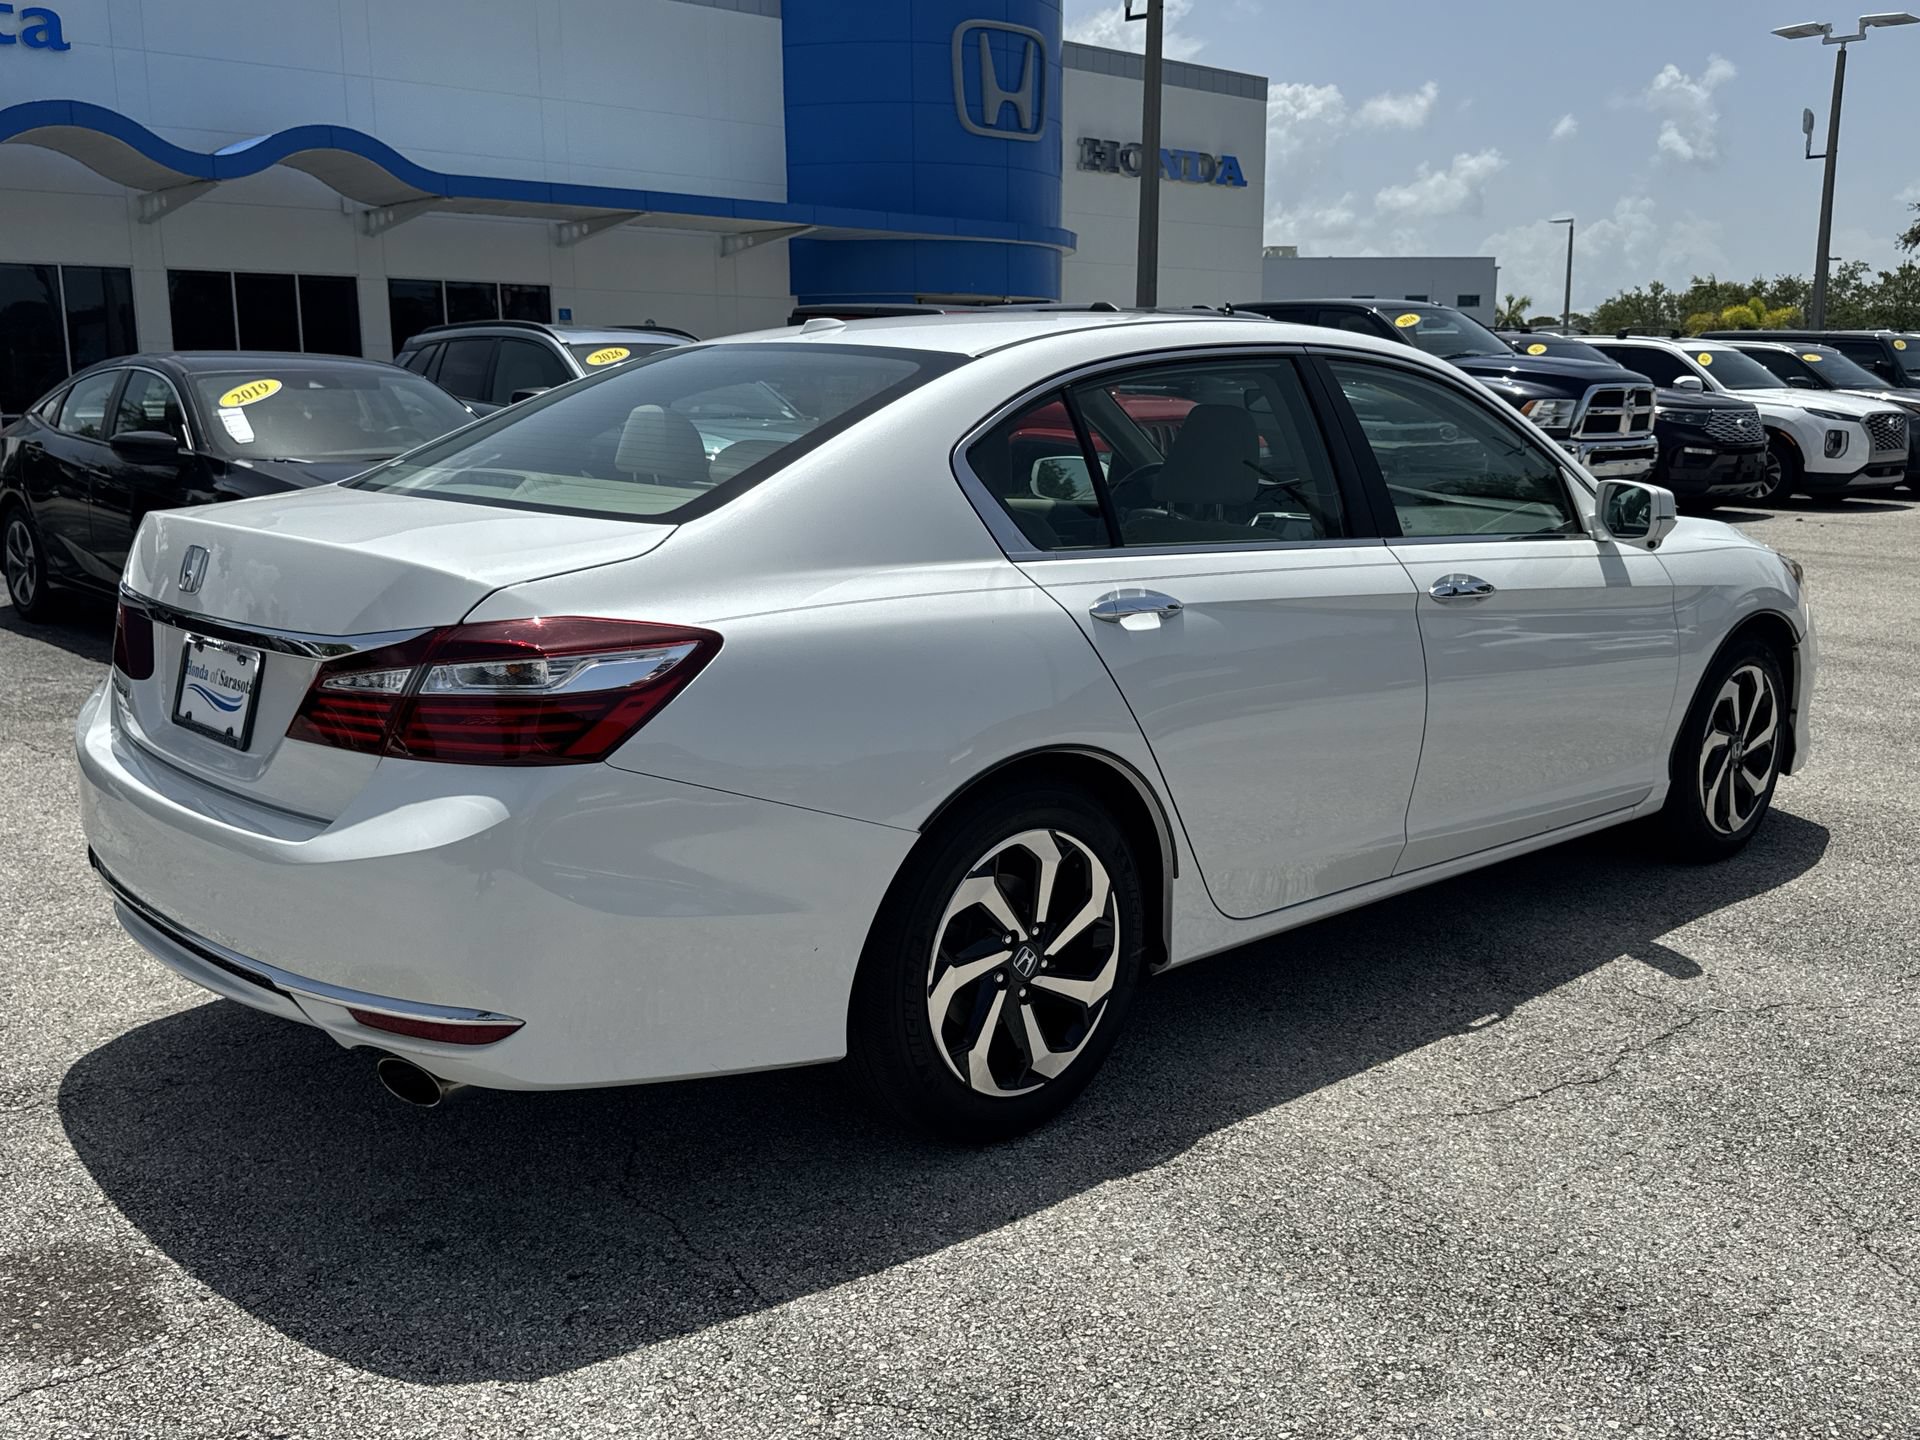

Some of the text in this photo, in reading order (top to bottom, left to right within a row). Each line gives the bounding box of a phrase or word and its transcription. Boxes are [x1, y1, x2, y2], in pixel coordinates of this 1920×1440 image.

[1077, 137, 1247, 187] HONDA
[594, 349, 623, 363] 2026
[231, 382, 270, 404] 2019
[210, 668, 220, 685] of
